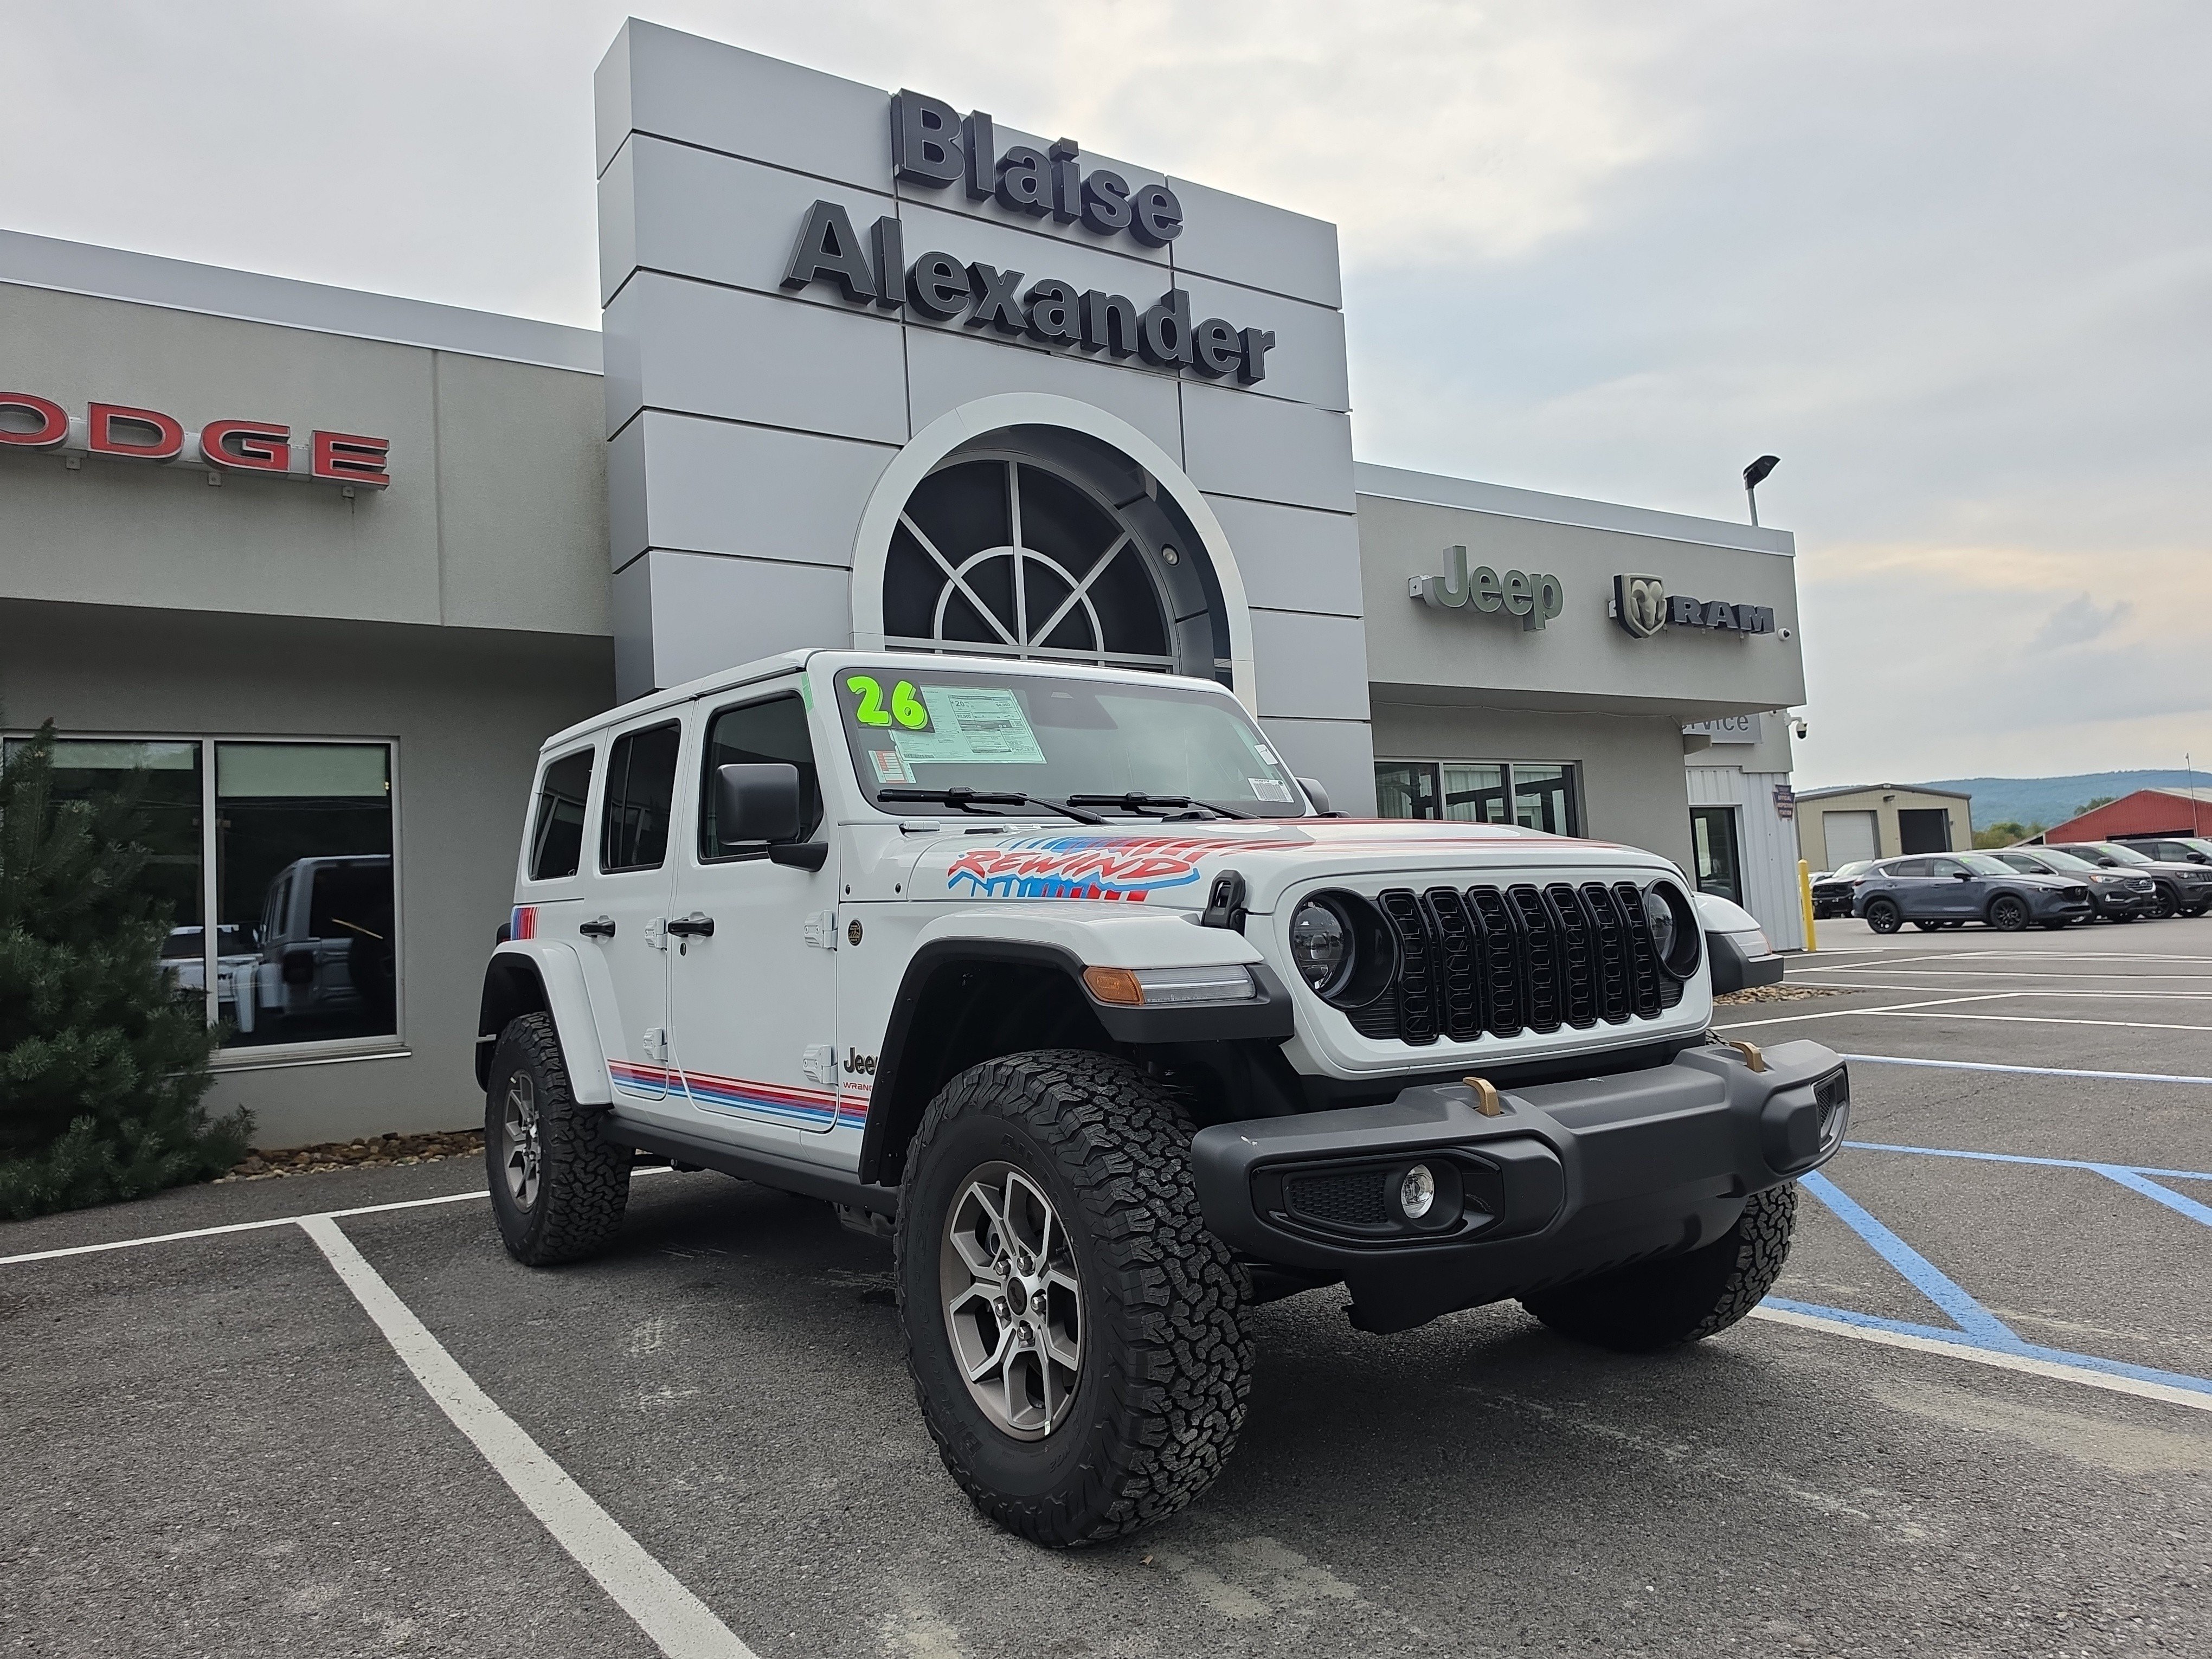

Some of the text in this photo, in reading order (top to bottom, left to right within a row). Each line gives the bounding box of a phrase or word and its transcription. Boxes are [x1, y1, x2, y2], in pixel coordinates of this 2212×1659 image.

[891, 88, 1184, 248] Blaise
[781, 200, 1276, 385] Alexander
[1423, 545, 1564, 632] Jeep
[1666, 596, 1775, 633] RAM
[846, 676, 928, 730] 26
[1681, 715, 1749, 731] vice
[948, 850, 1191, 879] REWIND
